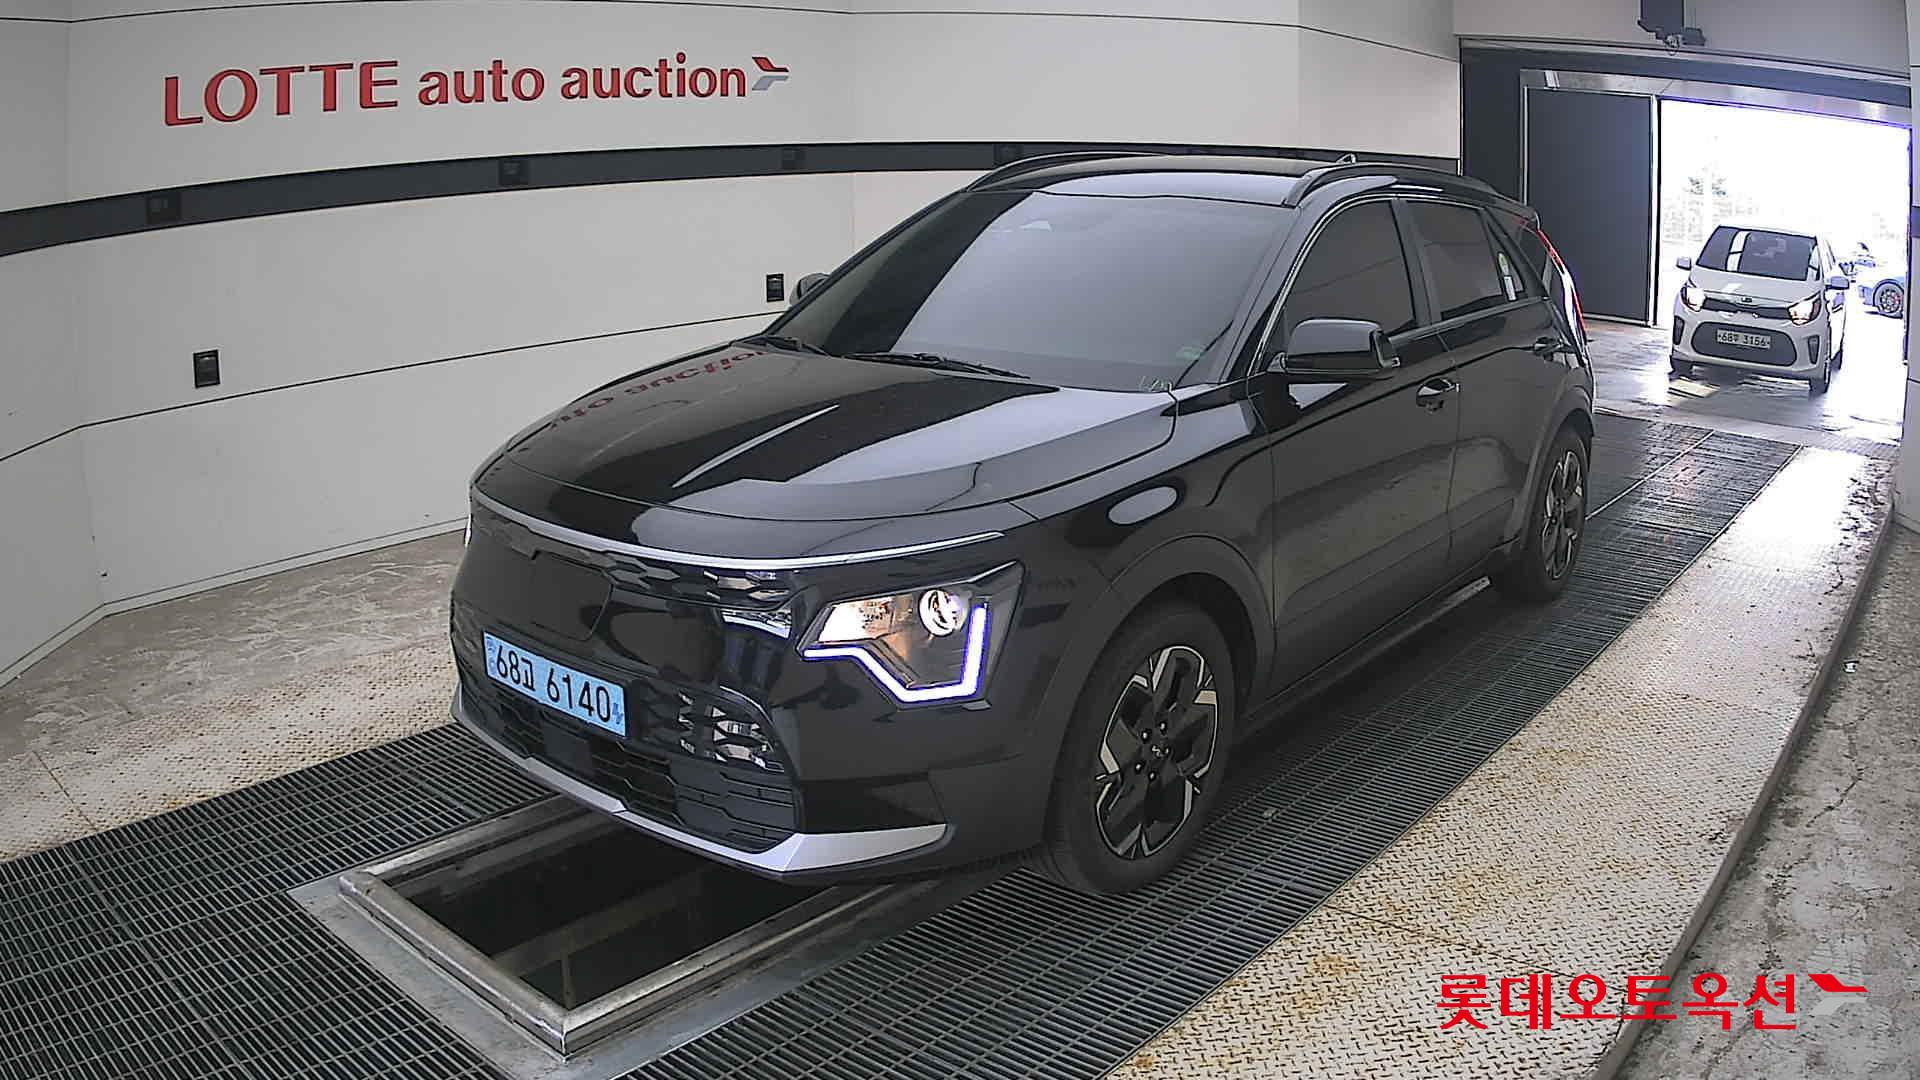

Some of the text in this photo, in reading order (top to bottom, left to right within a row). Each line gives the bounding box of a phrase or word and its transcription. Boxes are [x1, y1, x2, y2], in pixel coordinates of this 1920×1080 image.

[164, 52, 747, 126] LOTTE auto auction
[496, 645, 536, 692] 68고
[547, 668, 611, 722] 6140
